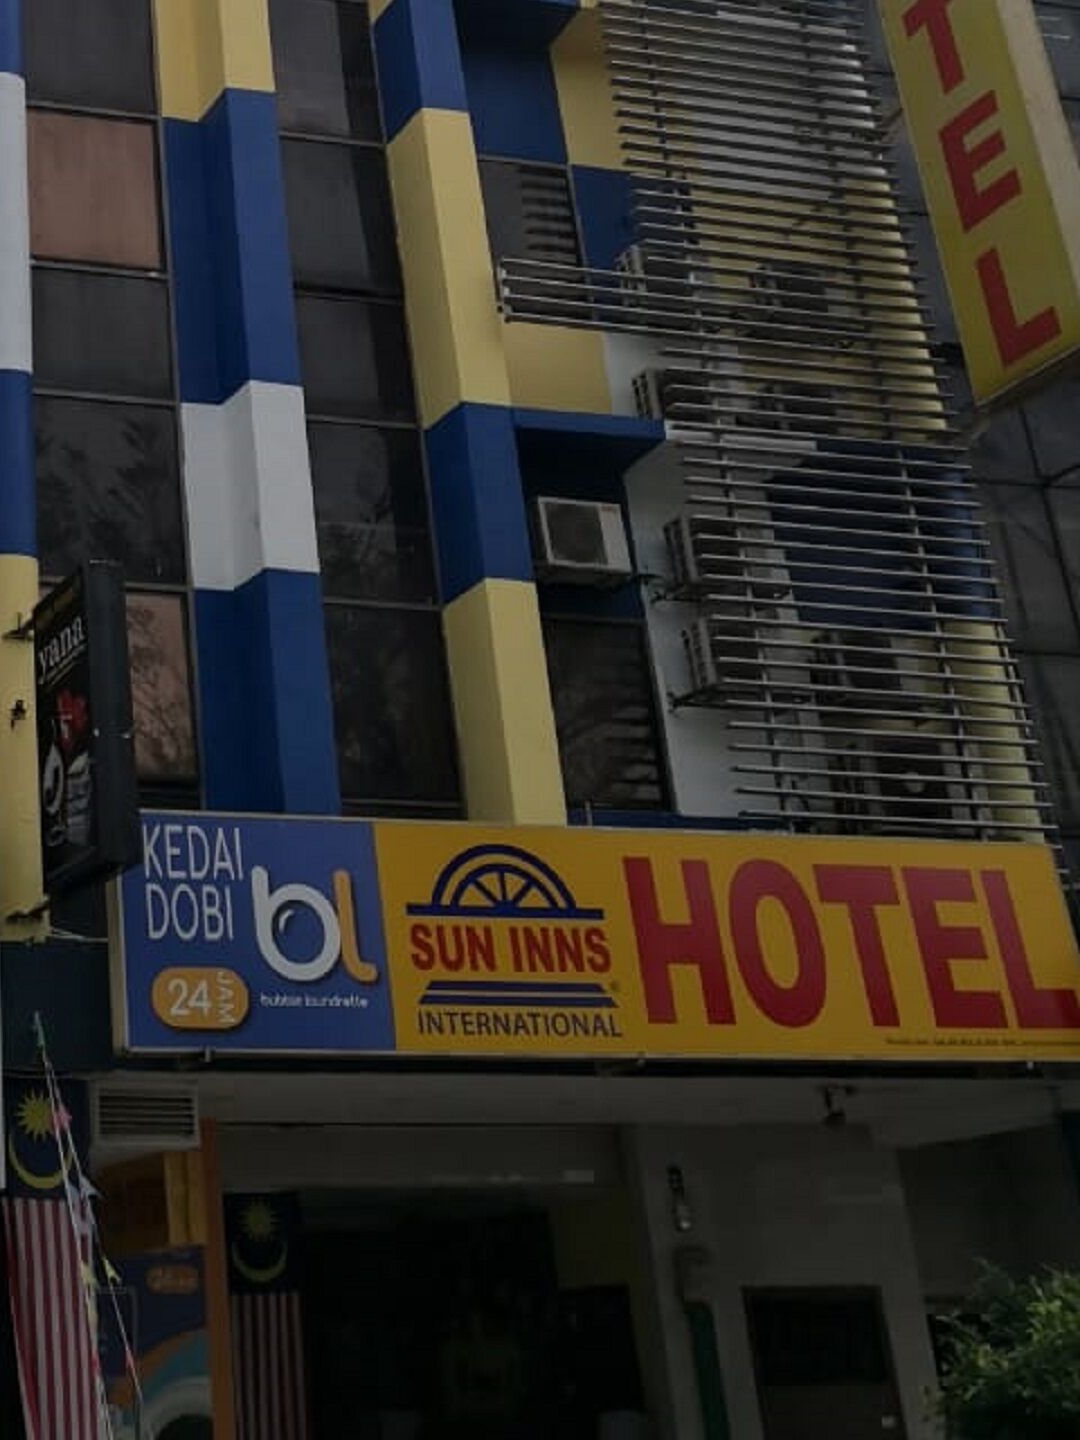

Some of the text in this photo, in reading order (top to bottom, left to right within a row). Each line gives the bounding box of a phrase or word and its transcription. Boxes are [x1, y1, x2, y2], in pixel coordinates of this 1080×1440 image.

[141, 823, 244, 882] KEDAI
[145, 882, 235, 942] DOBI
[410, 923, 612, 974] SUN INNS
[622, 855, 1080, 1030] HOTEL
[167, 970, 236, 1024] 24 JAM
[417, 1011, 624, 1038] INTERNATIONAL
